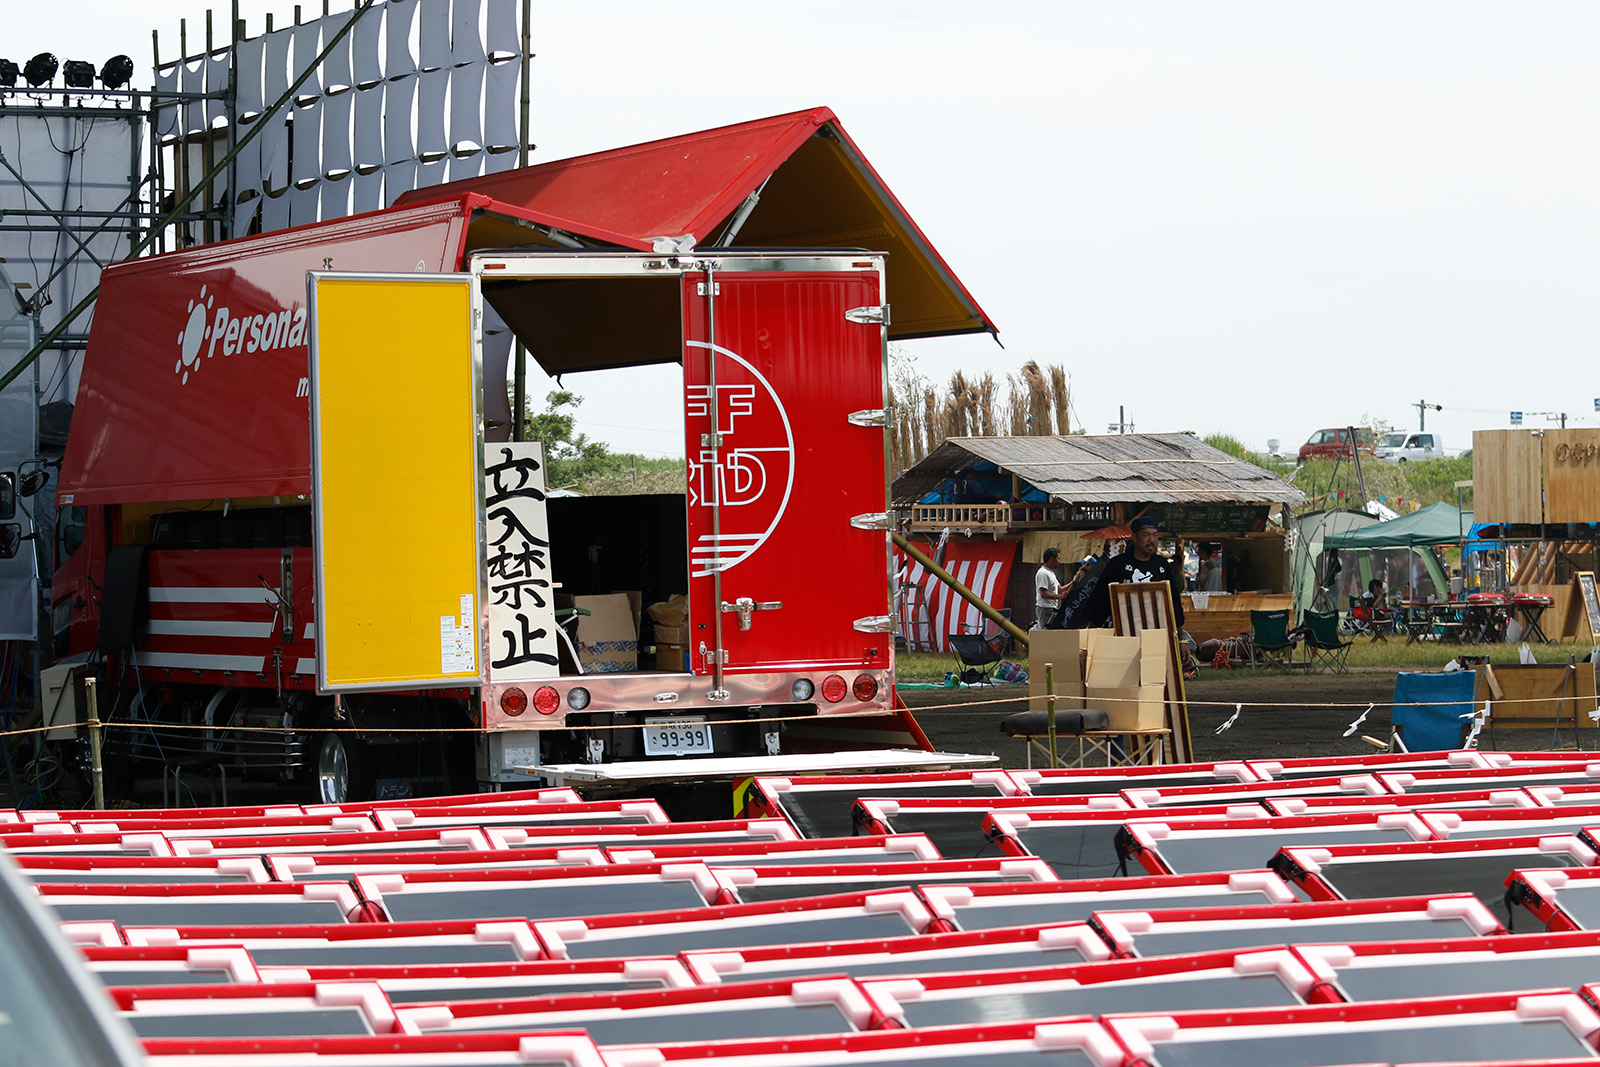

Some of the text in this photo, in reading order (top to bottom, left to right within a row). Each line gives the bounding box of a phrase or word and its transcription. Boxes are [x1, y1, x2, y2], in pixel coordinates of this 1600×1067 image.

[207, 306, 308, 358] Persona
[485, 447, 559, 669] 立入禁止
[660, 731, 705, 748] 99-99
